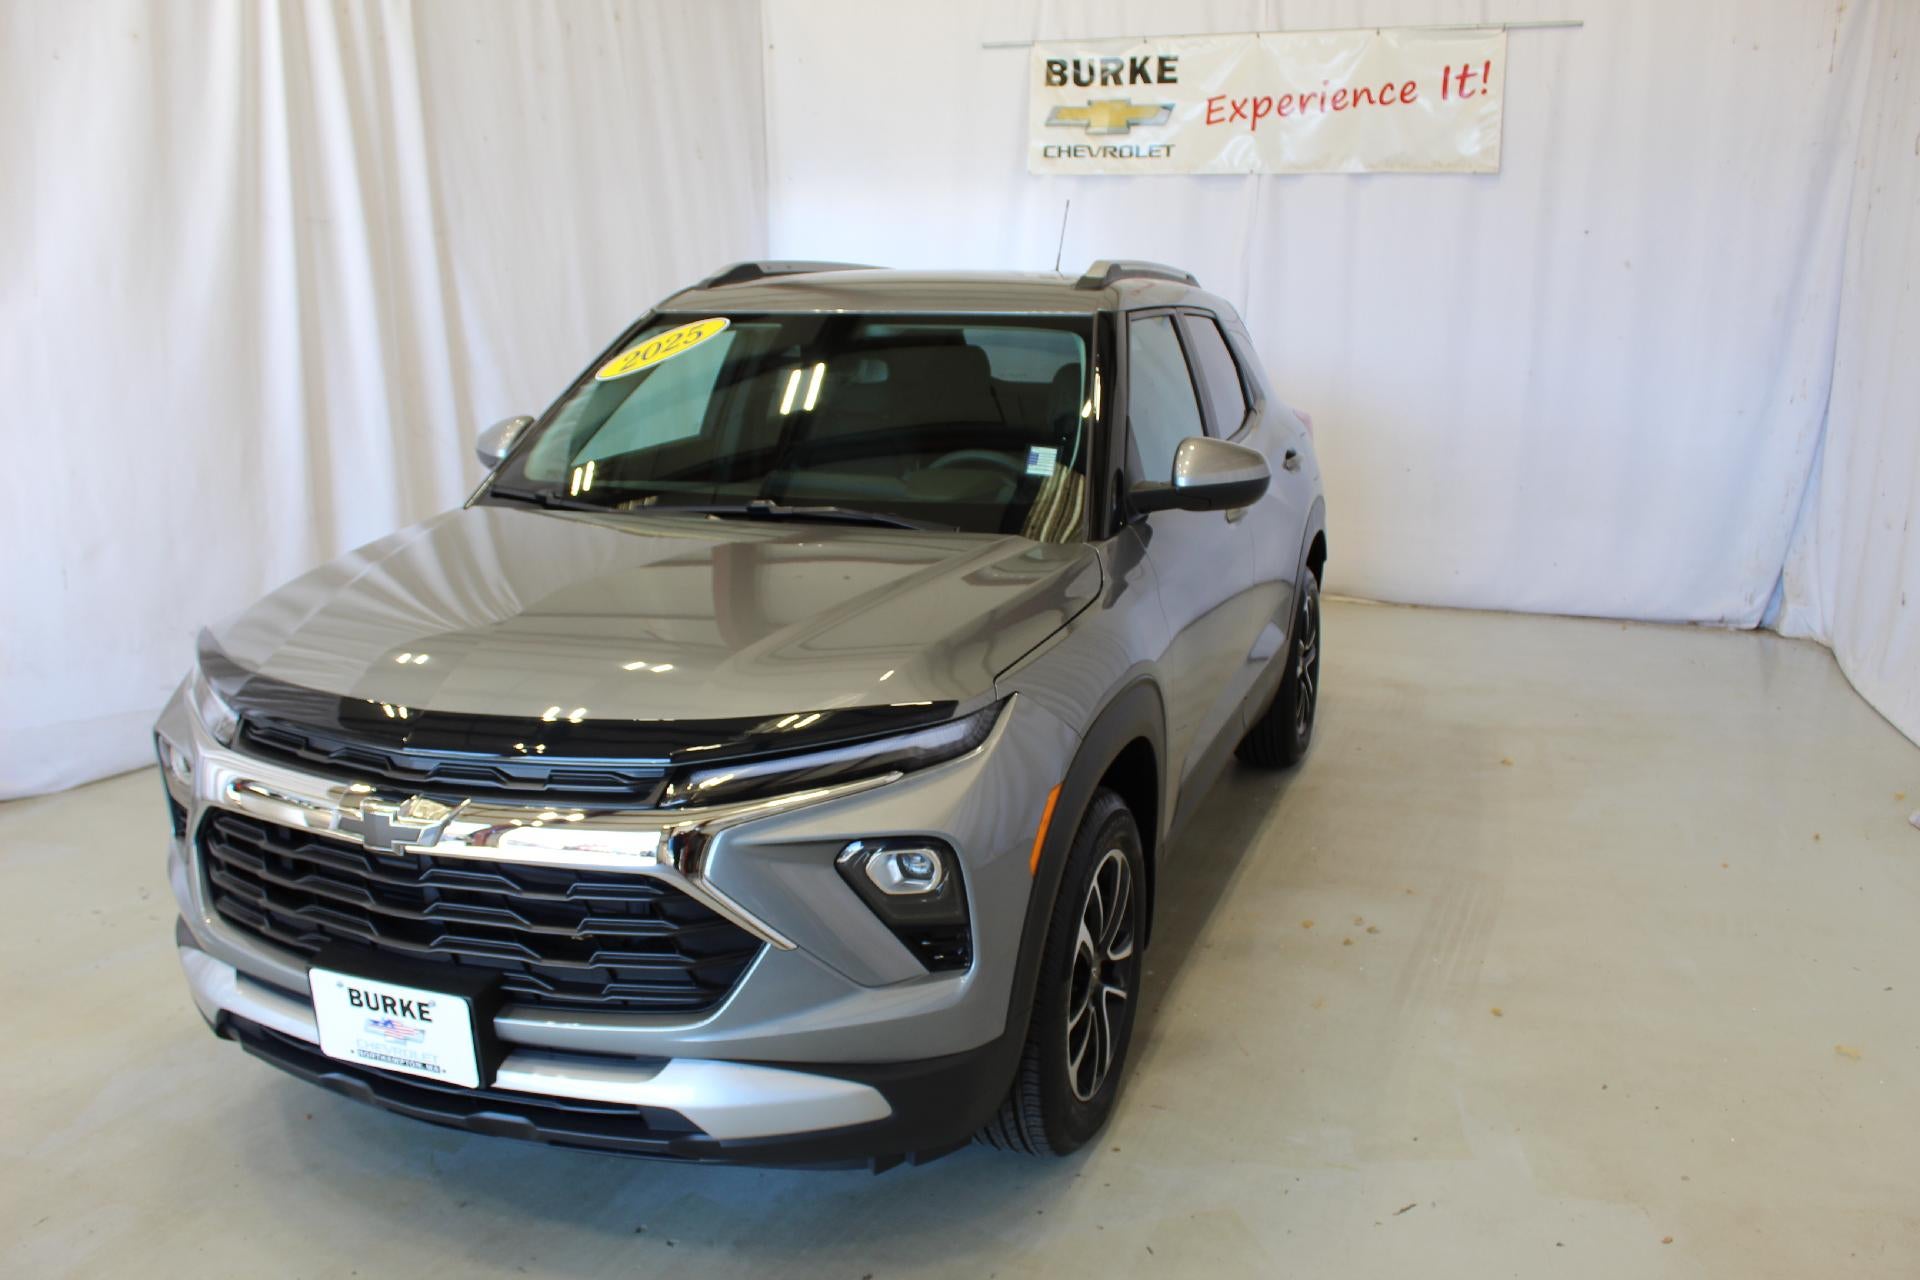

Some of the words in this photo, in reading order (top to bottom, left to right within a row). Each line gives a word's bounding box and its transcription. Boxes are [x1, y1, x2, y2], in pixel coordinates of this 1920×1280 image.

[1044, 55, 1179, 87] BURKE
[1206, 80, 1418, 130] Experience
[1442, 61, 1492, 101] It!
[1043, 143, 1175, 159] CHEVROLET
[620, 324, 704, 371] 2025
[347, 988, 432, 1022] BURKE
[357, 1038, 438, 1063] CHEVROLET
